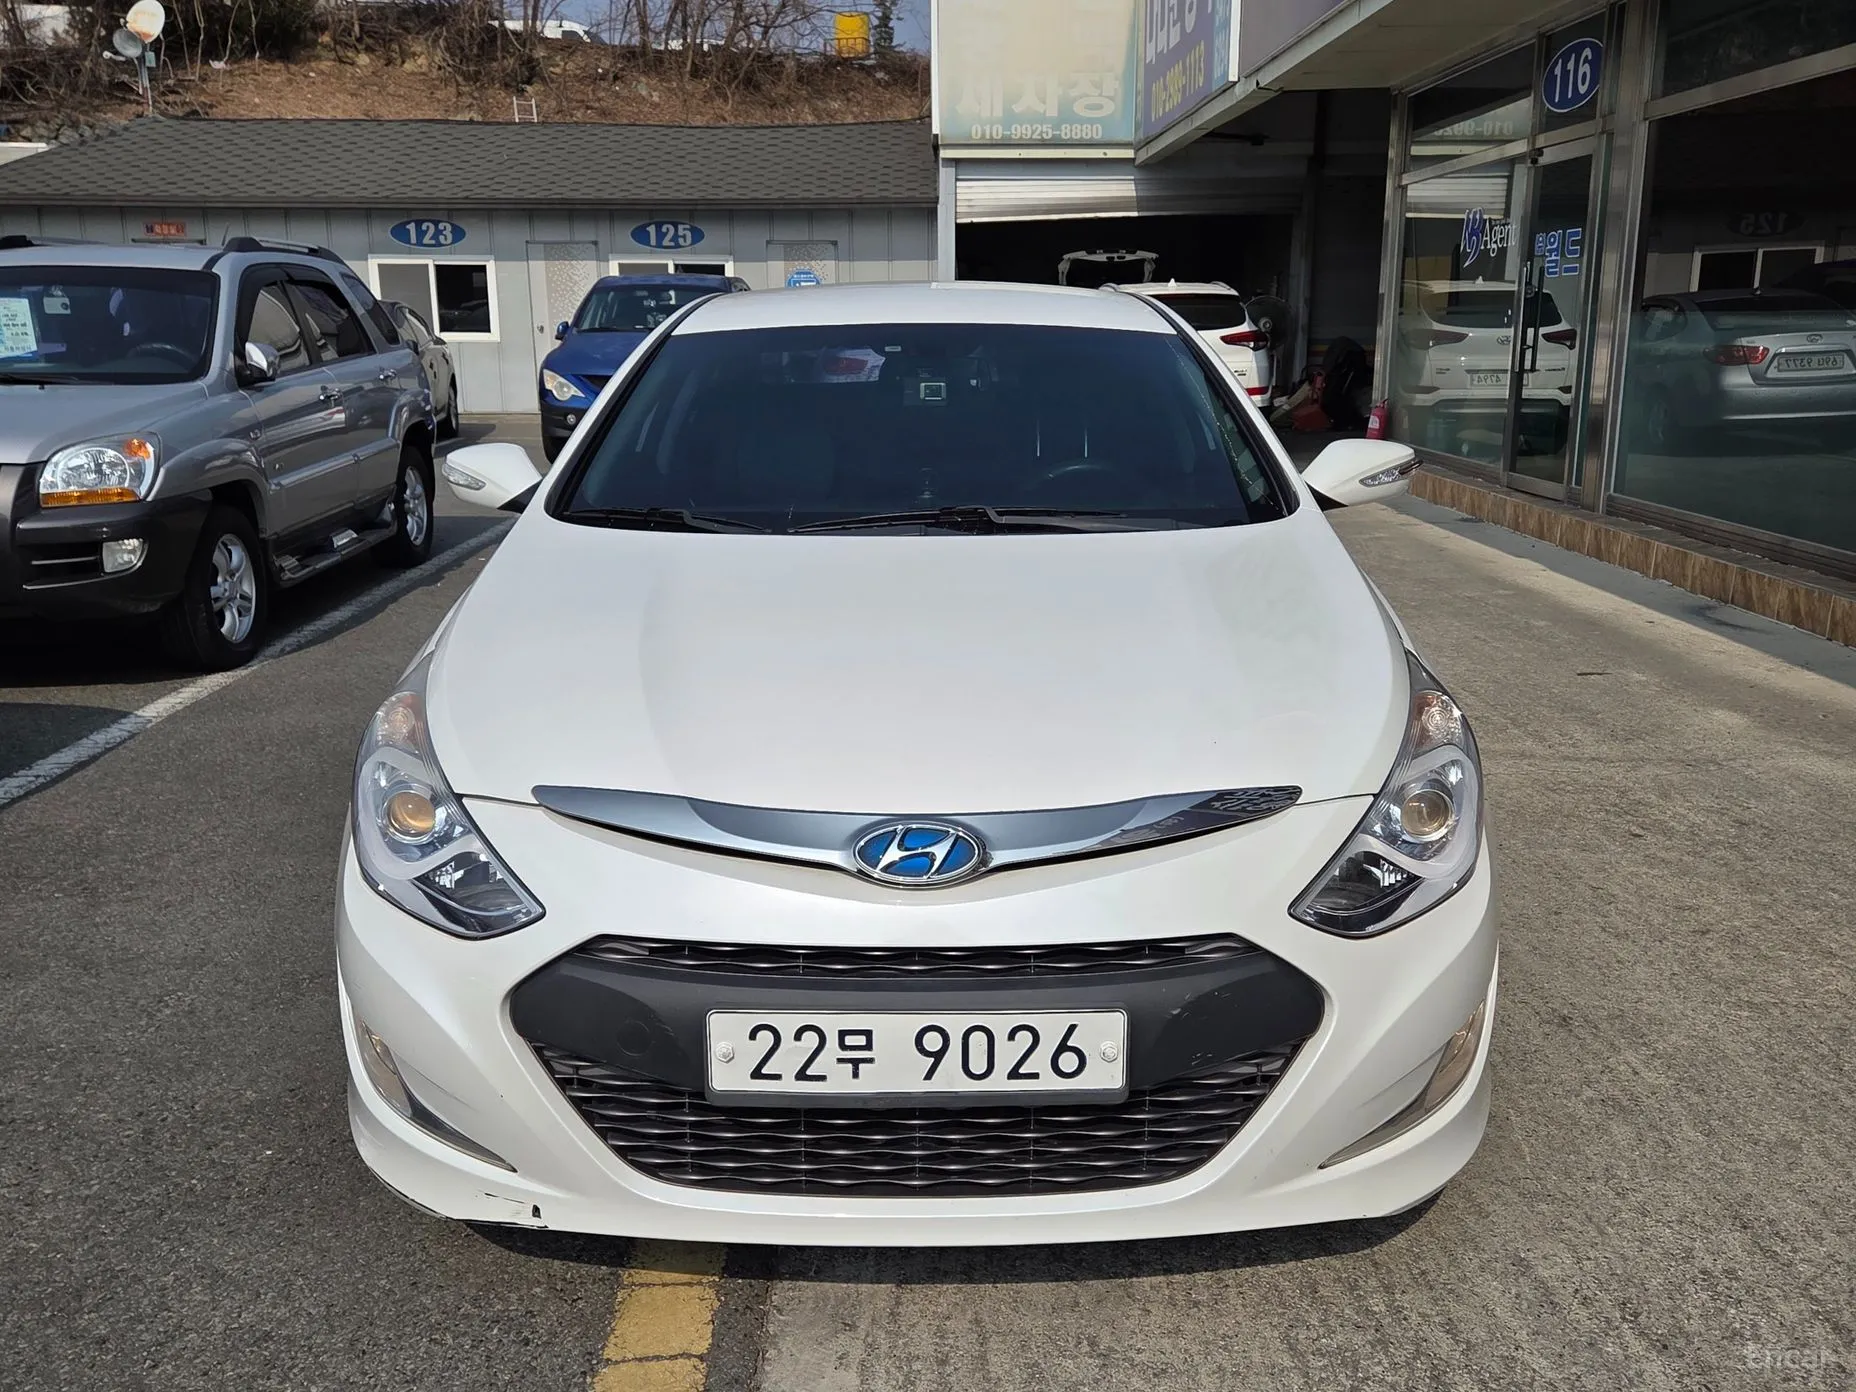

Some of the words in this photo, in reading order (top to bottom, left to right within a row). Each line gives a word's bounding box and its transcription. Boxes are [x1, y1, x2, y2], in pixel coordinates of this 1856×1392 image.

[1554, 47, 1592, 103] 116
[971, 123, 1102, 139] 010-9925-8880
[406, 222, 453, 245] 123
[646, 223, 692, 247] 125
[1481, 218, 1517, 257] Agent
[748, 1023, 876, 1083] 22무
[914, 1023, 1088, 1082] 9026
